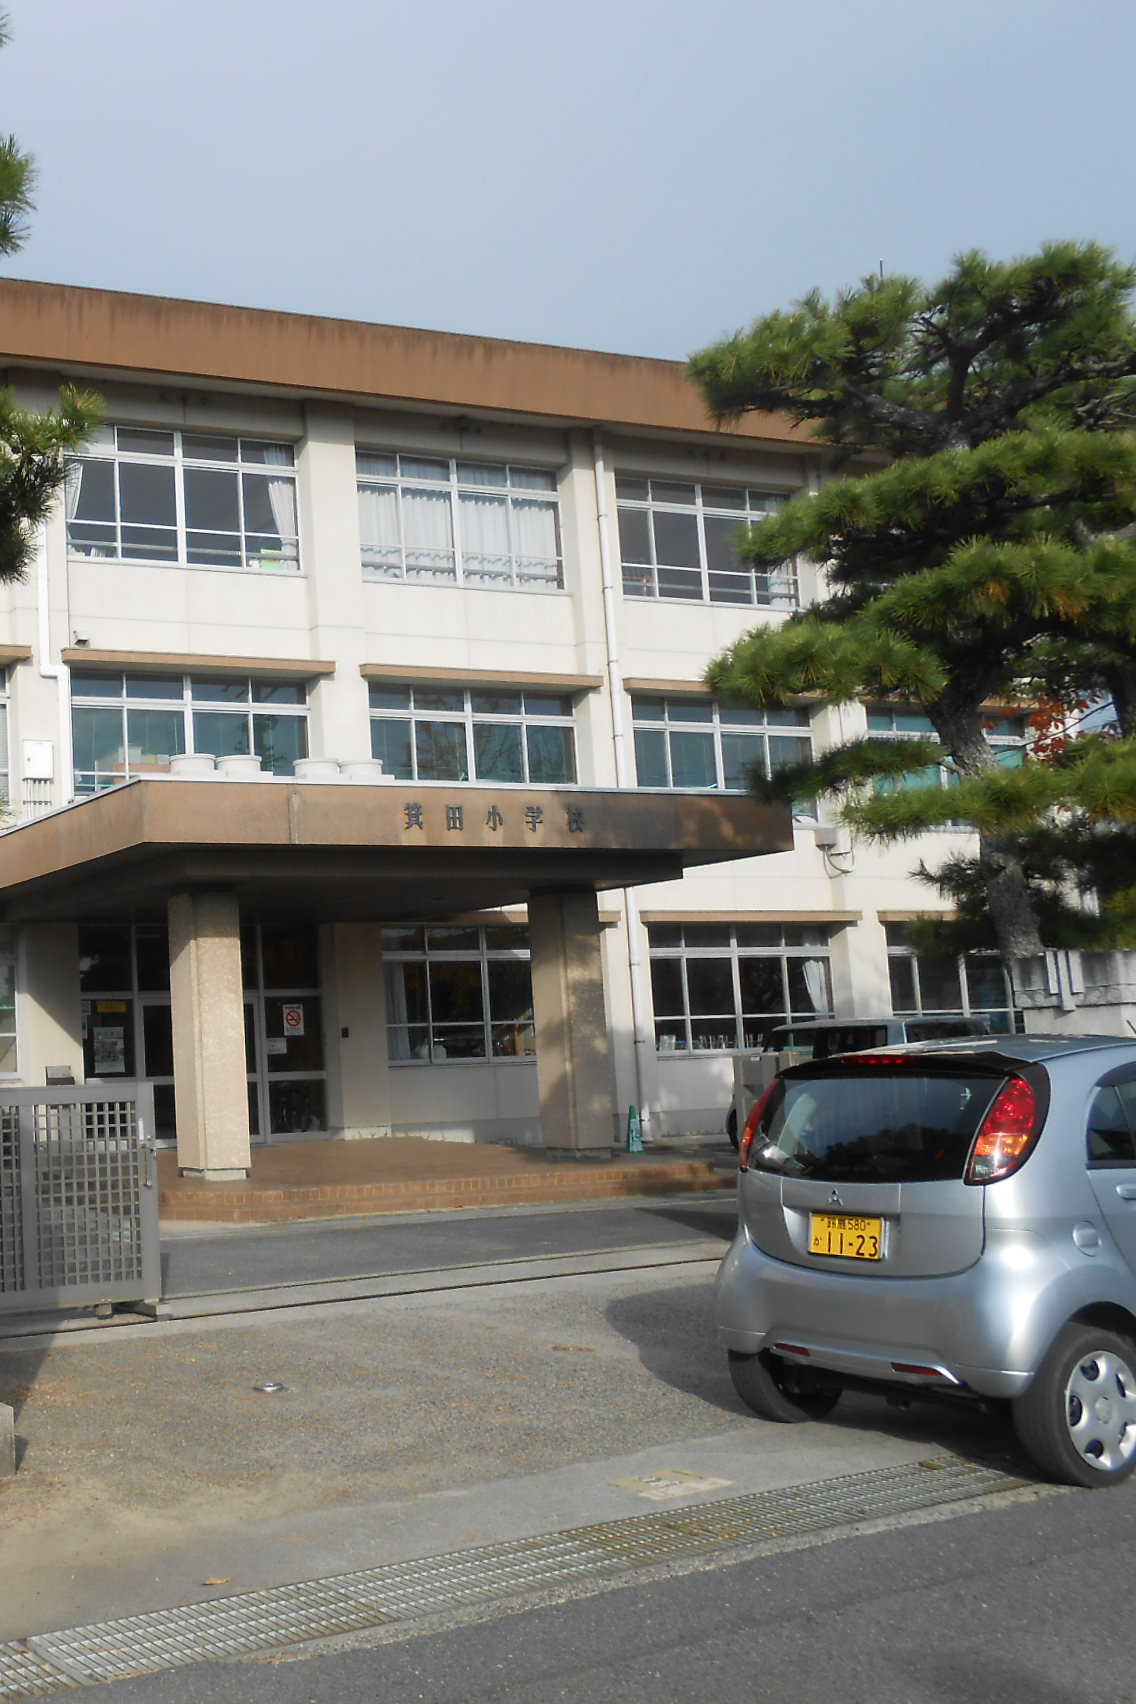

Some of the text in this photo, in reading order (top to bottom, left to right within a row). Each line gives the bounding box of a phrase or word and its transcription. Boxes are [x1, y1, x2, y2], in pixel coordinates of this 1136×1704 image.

[404, 803, 585, 832] 箕田小学校
[827, 1231, 878, 1257] 11-23
